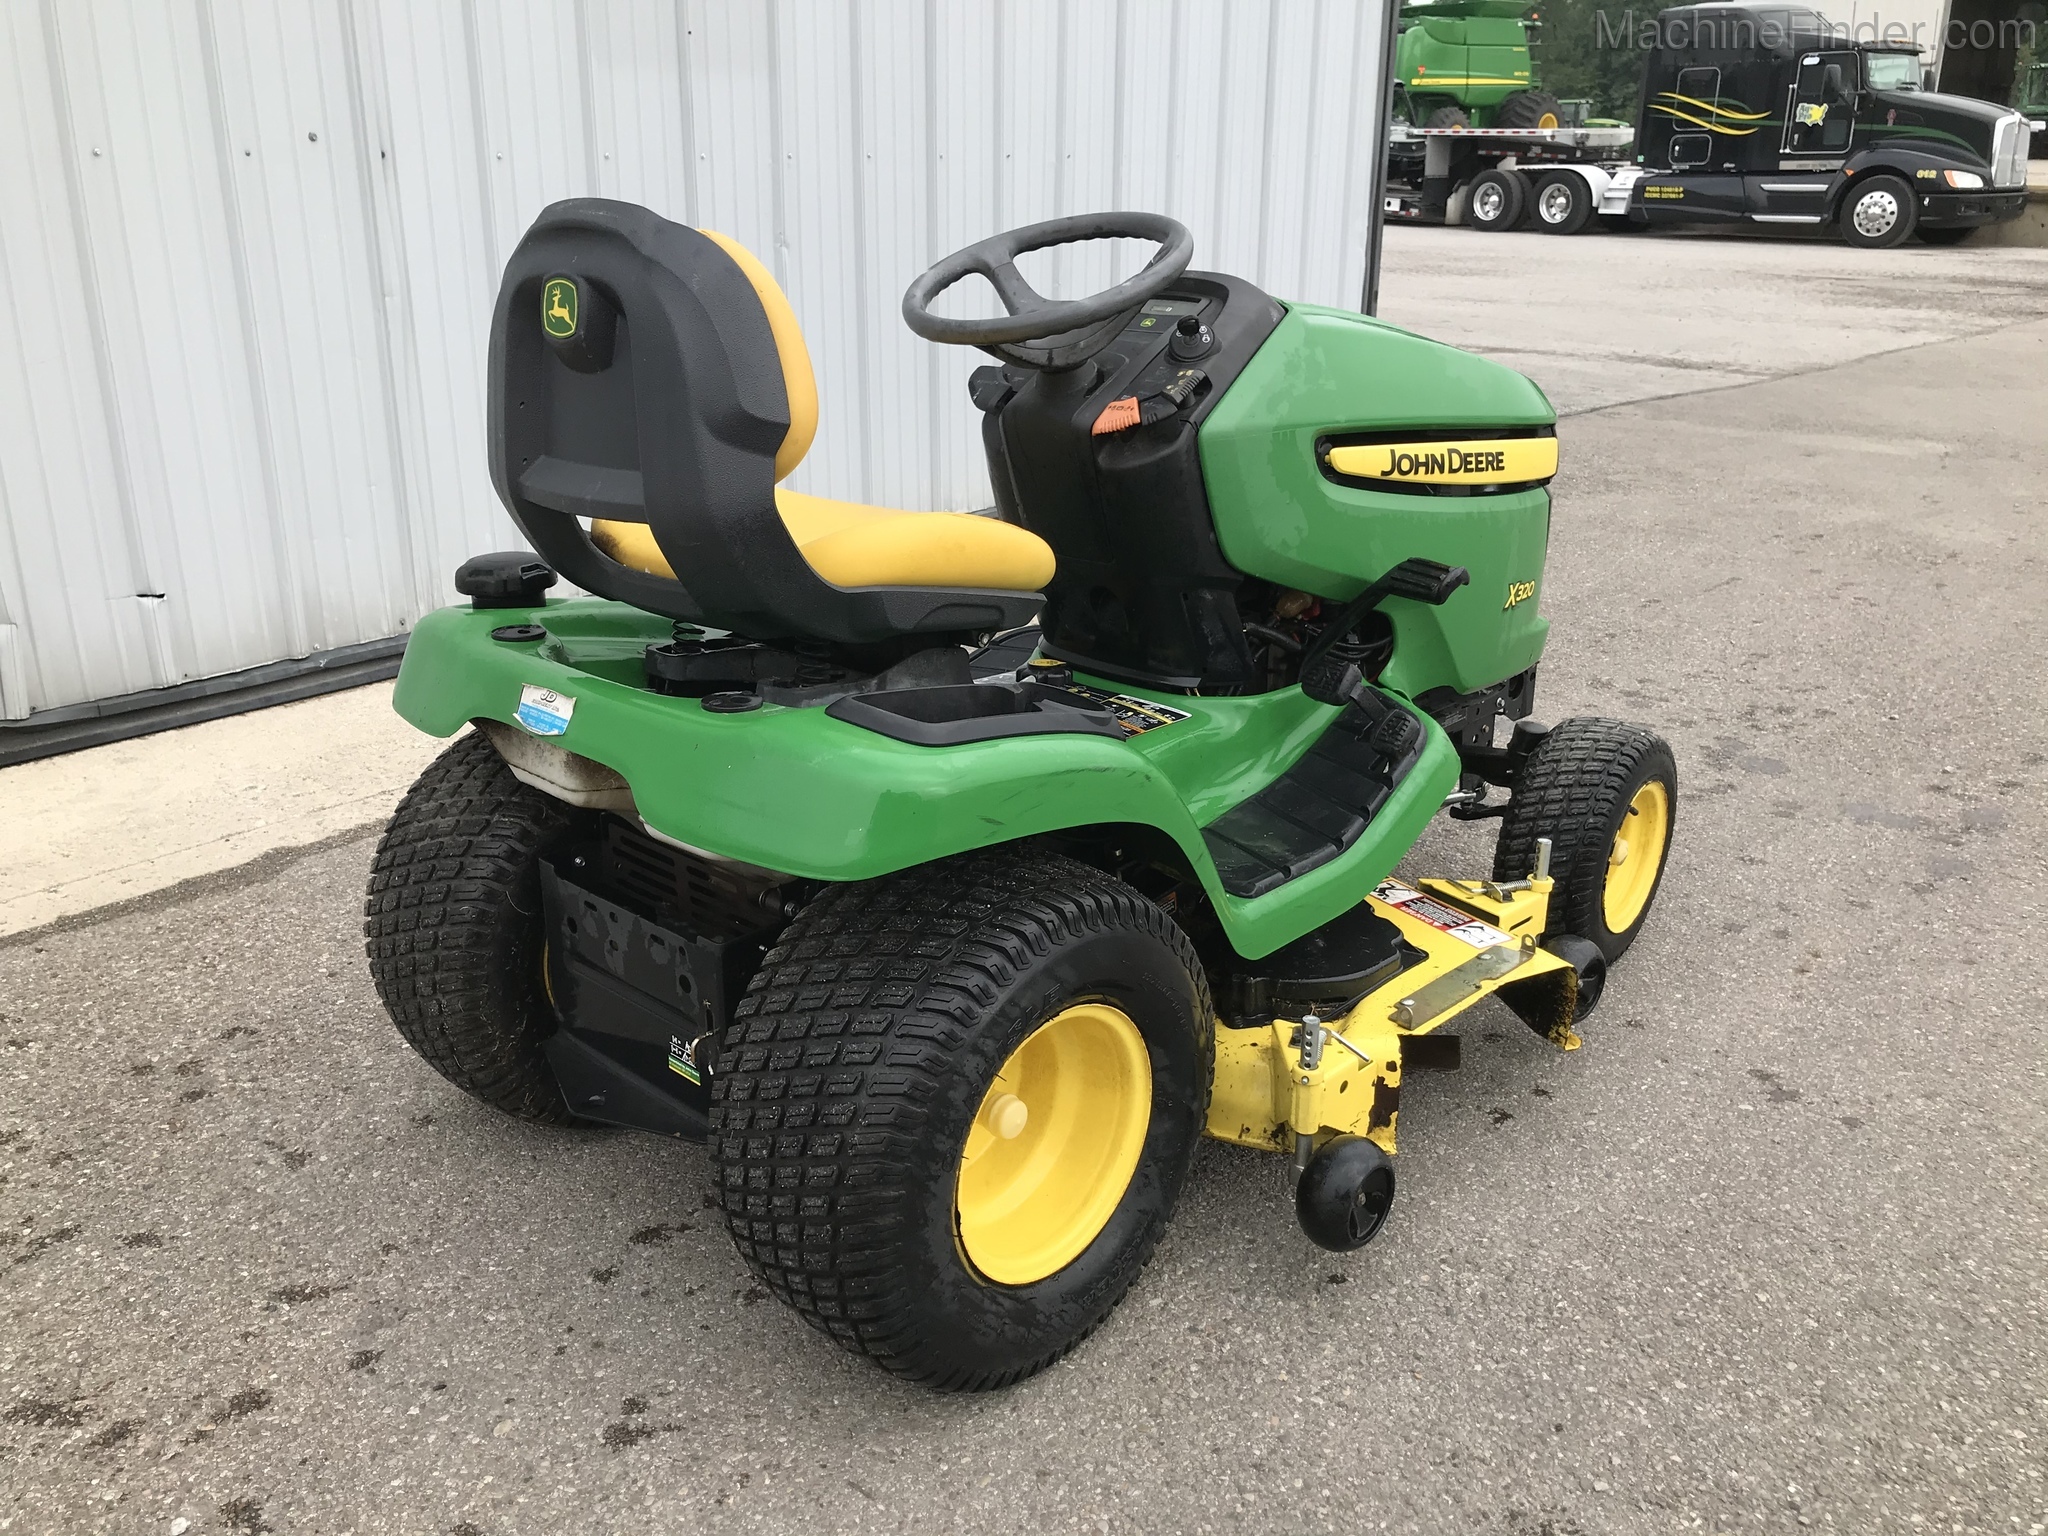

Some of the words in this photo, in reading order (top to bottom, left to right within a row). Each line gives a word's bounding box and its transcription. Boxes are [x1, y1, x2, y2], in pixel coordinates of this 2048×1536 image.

[1381, 449, 1446, 477] JOHN
[1447, 448, 1505, 475] DEERE
[1503, 580, 1536, 611] X320
[540, 689, 558, 703] JD
